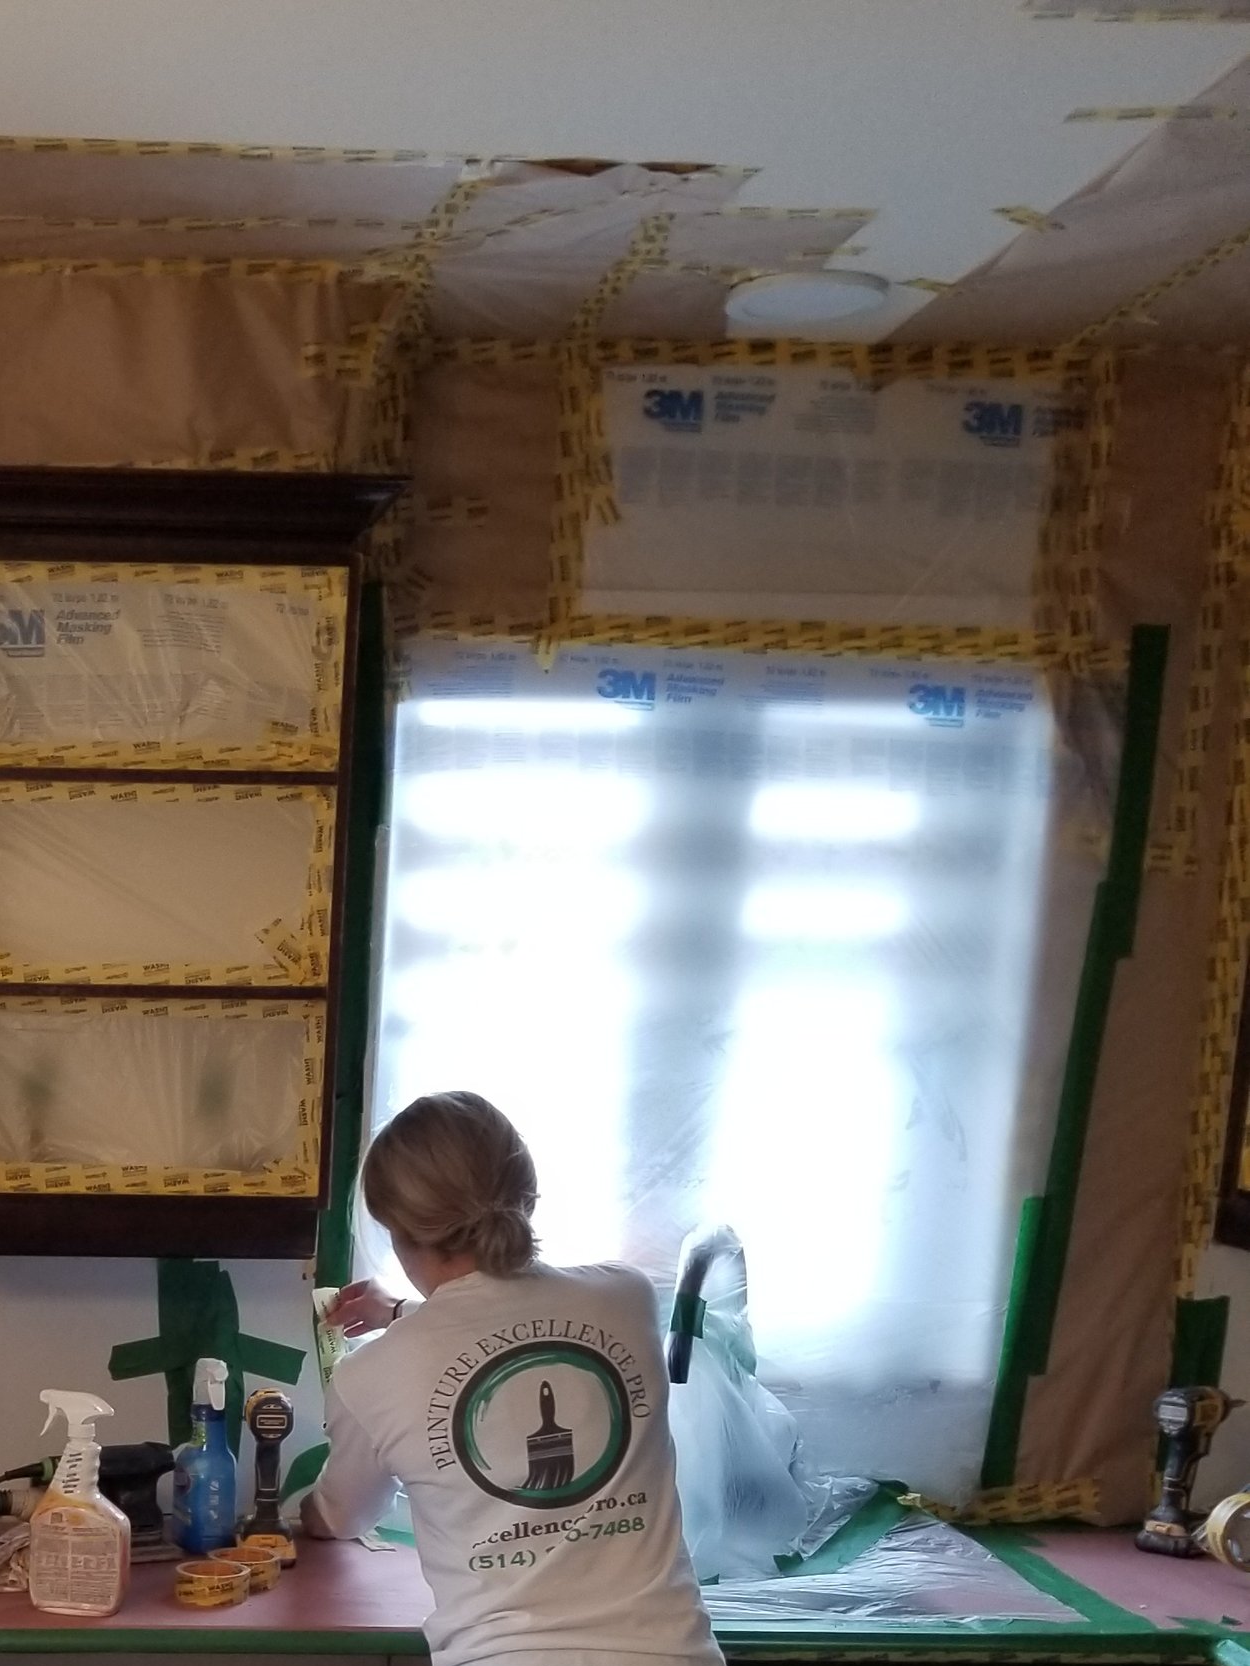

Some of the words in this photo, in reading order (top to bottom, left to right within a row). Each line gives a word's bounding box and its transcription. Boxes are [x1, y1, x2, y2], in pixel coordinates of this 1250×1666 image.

[643, 388, 704, 420] 3M
[962, 401, 1025, 435] 3M
[56, 608, 122, 622] Advanced
[56, 621, 113, 636] Masking
[56, 634, 85, 645] Film
[597, 668, 656, 700] 3M
[908, 683, 967, 717] 3M
[427, 1352, 480, 1471] PEINTURE
[475, 1318, 638, 1372] EXCELLENCE
[625, 1372, 651, 1419] PRO
[468, 1550, 537, 1572] (514)
